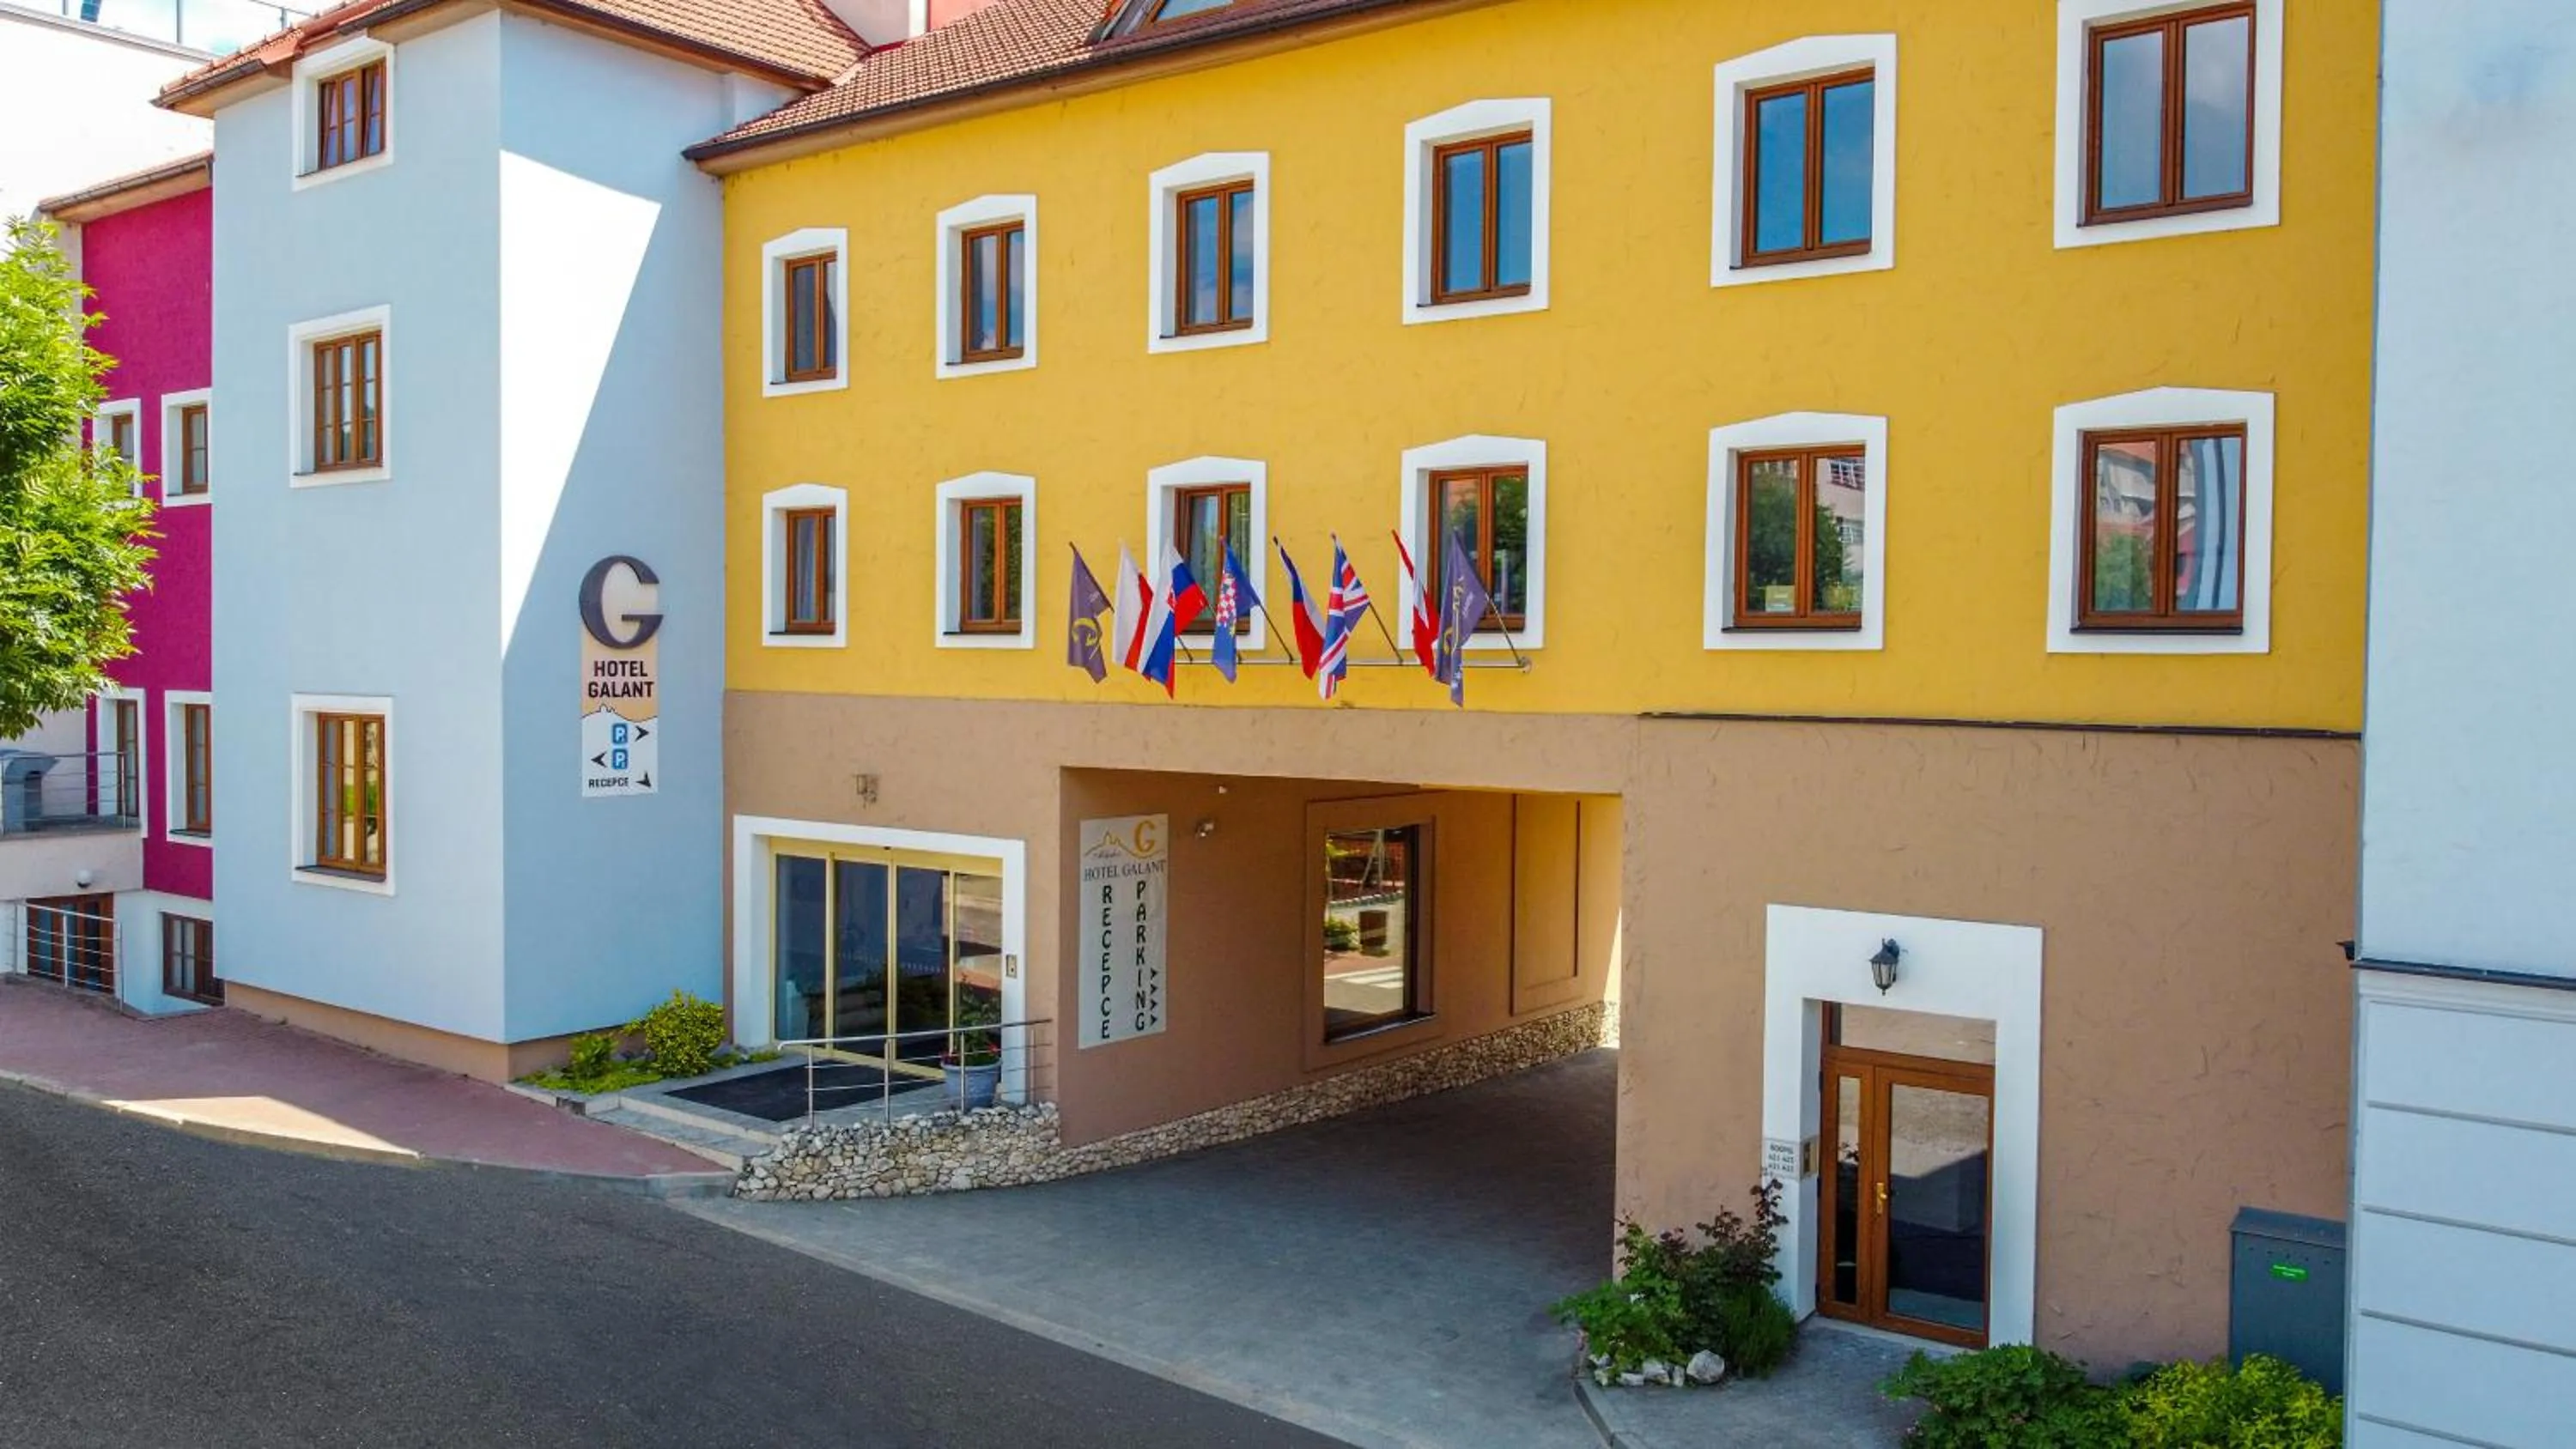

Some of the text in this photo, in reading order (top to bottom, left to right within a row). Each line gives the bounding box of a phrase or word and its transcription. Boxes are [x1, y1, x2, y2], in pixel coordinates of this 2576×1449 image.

[579, 555, 664, 650] G
[593, 660, 648, 678] HOTEL
[588, 681, 654, 699] GALANT
[588, 776, 629, 789] RECEPCE
[1134, 820, 1157, 853] G
[1084, 859, 1166, 882] HOTEL GALANT
[1100, 885, 1113, 1040] RECEPCE
[1135, 880, 1147, 1032] PARKING
